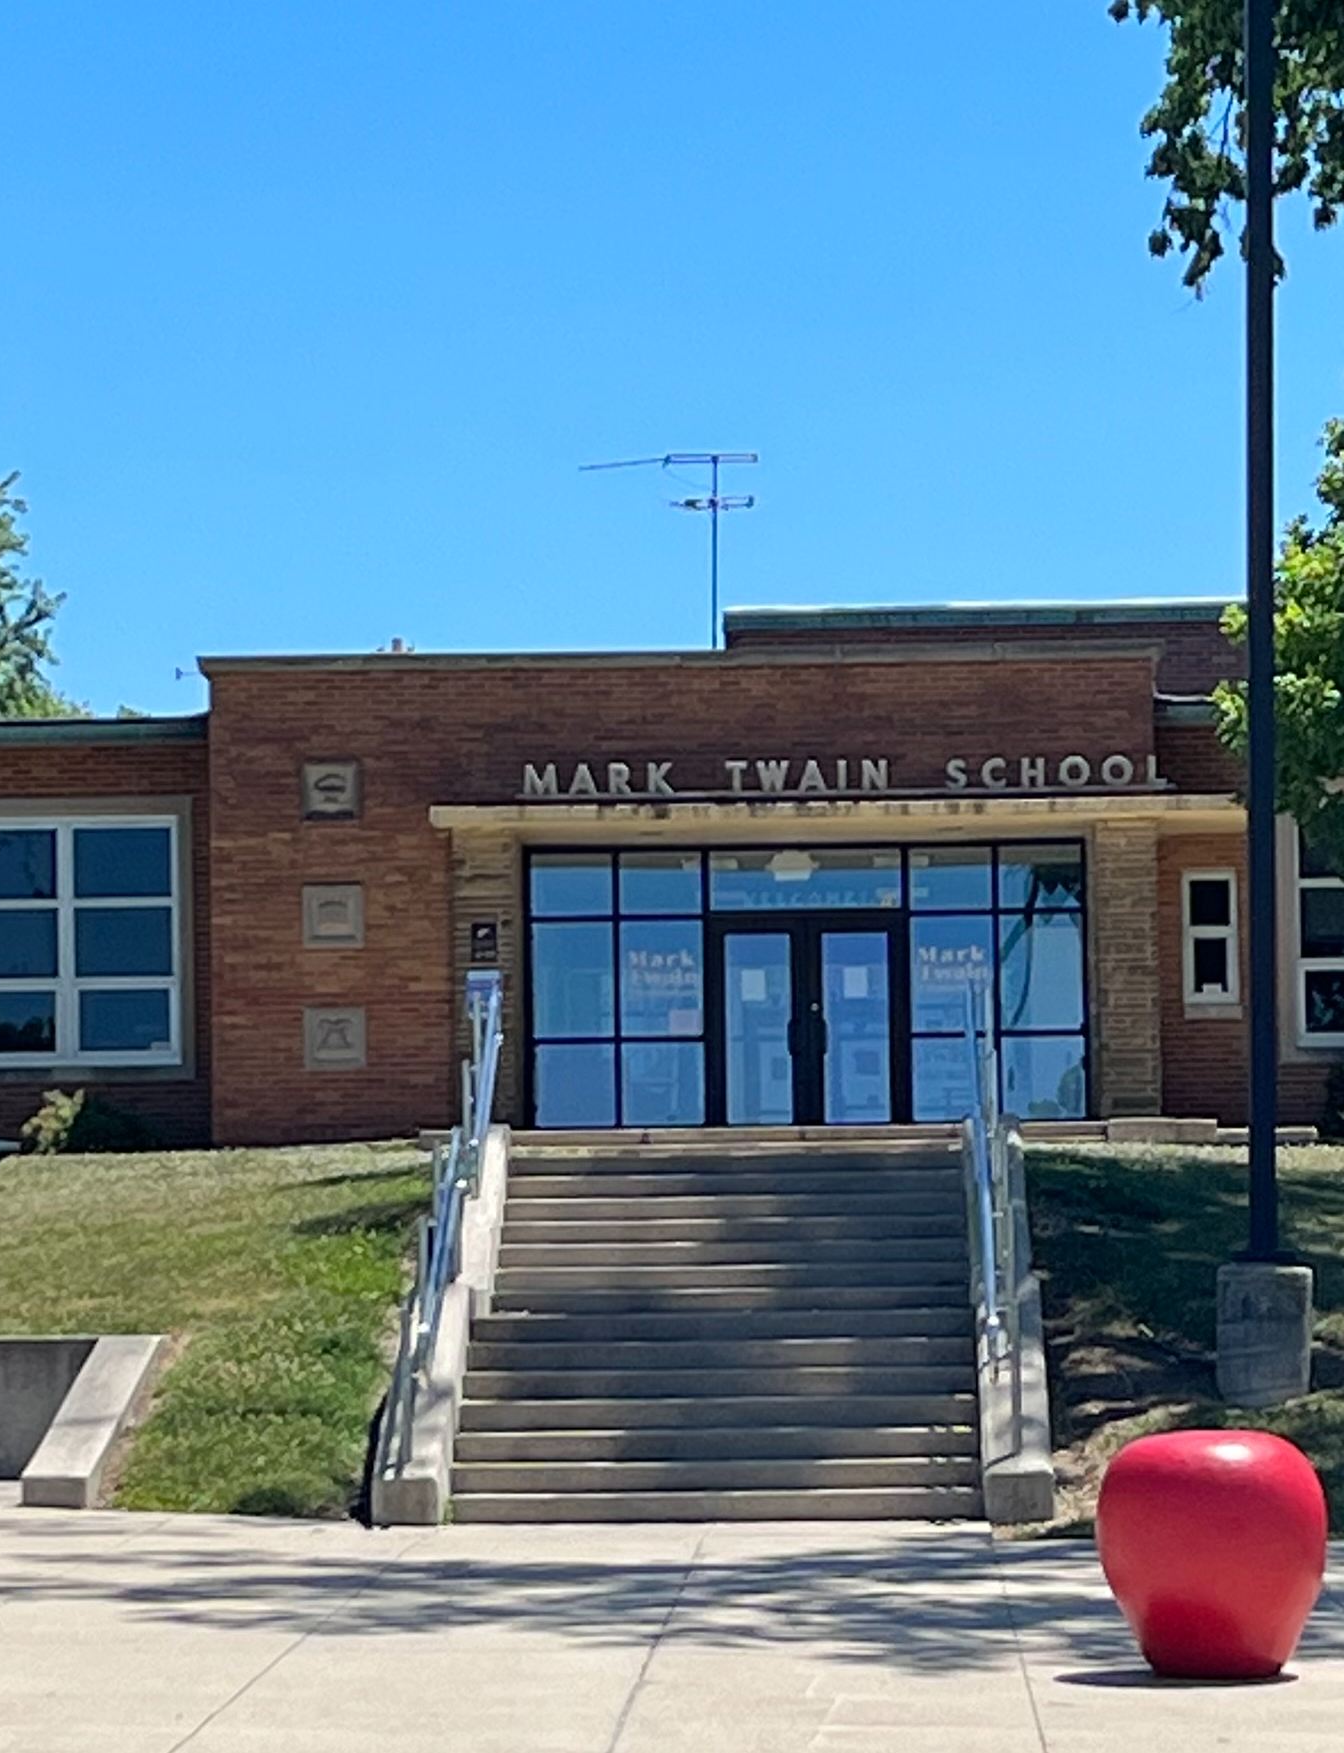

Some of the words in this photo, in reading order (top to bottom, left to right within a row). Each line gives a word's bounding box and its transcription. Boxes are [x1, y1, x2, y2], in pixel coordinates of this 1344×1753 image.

[523, 762, 674, 796] MARK
[725, 759, 888, 793] TWAIN
[945, 755, 1167, 789] SCHOOL
[628, 949, 695, 967] Mark
[917, 945, 984, 963] Mark
